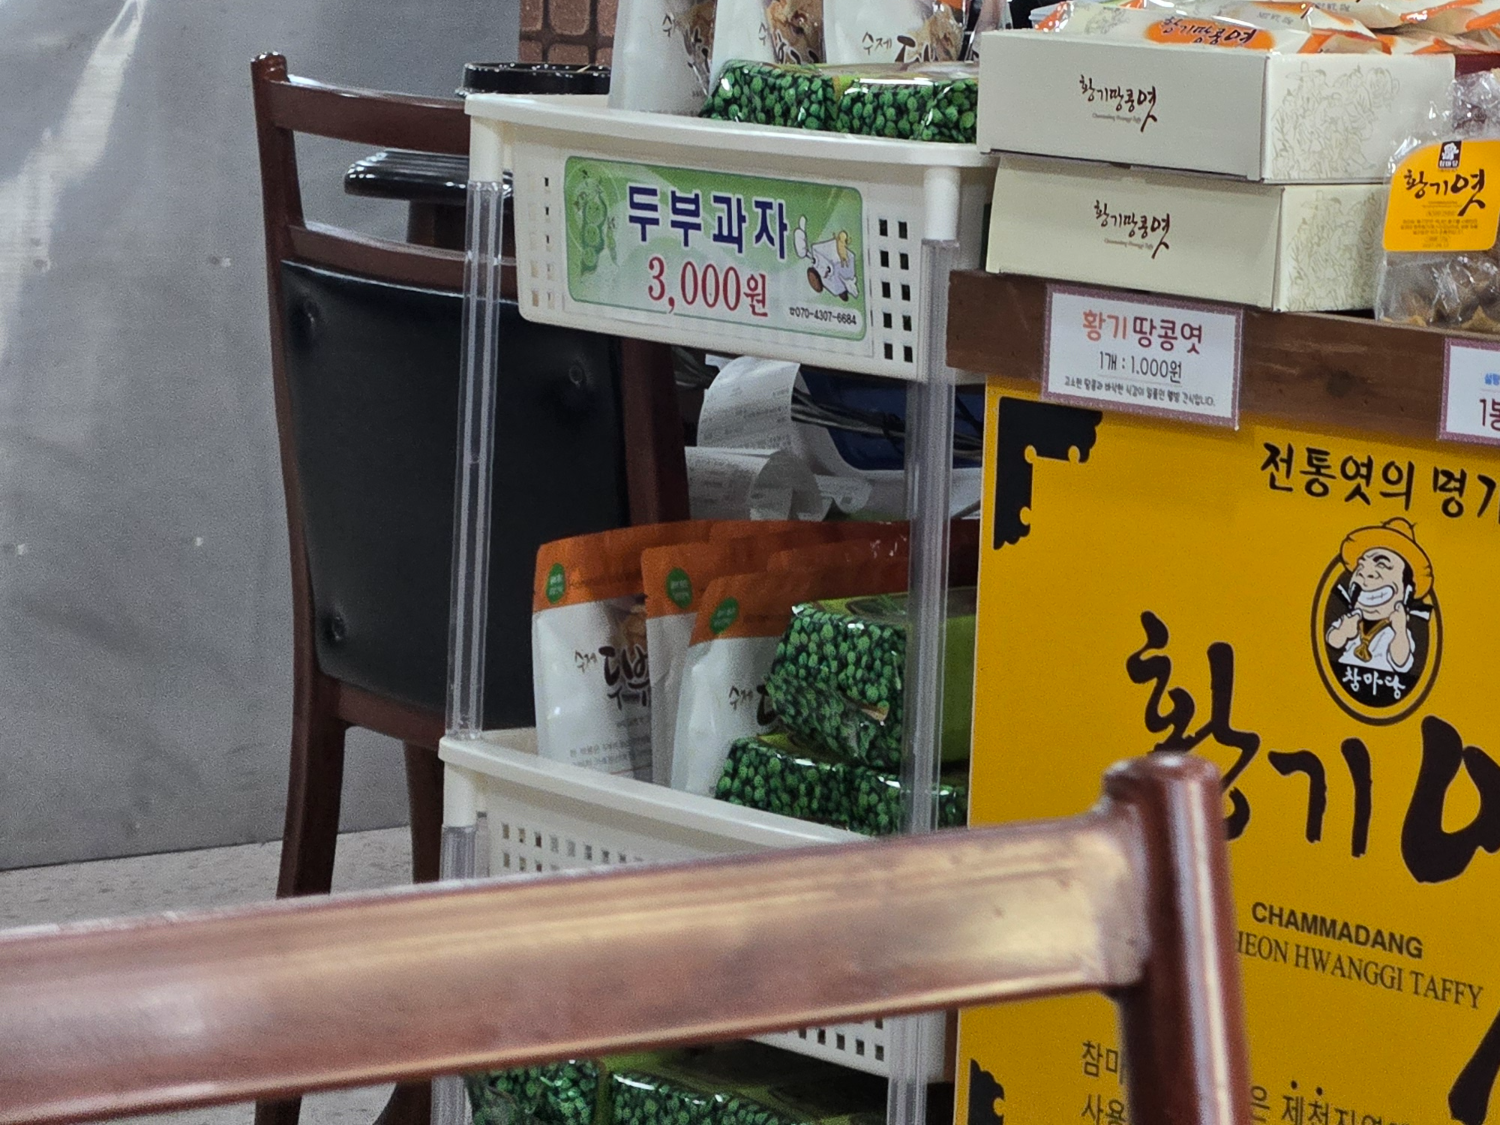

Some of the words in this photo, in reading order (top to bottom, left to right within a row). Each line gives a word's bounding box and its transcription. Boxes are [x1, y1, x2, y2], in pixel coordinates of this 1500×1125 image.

[1079, 74, 1157, 132] 황기땅콩엿
[627, 184, 789, 261] 두부과자
[1403, 169, 1486, 217] 황기엿
[648, 256, 769, 318] 3,000원
[1261, 442, 1415, 511] 전통엿의
[1251, 901, 1423, 959] CHAMMADANG
[1295, 944, 1403, 993] HWANGGI
[1410, 970, 1484, 1010] TAFFY
